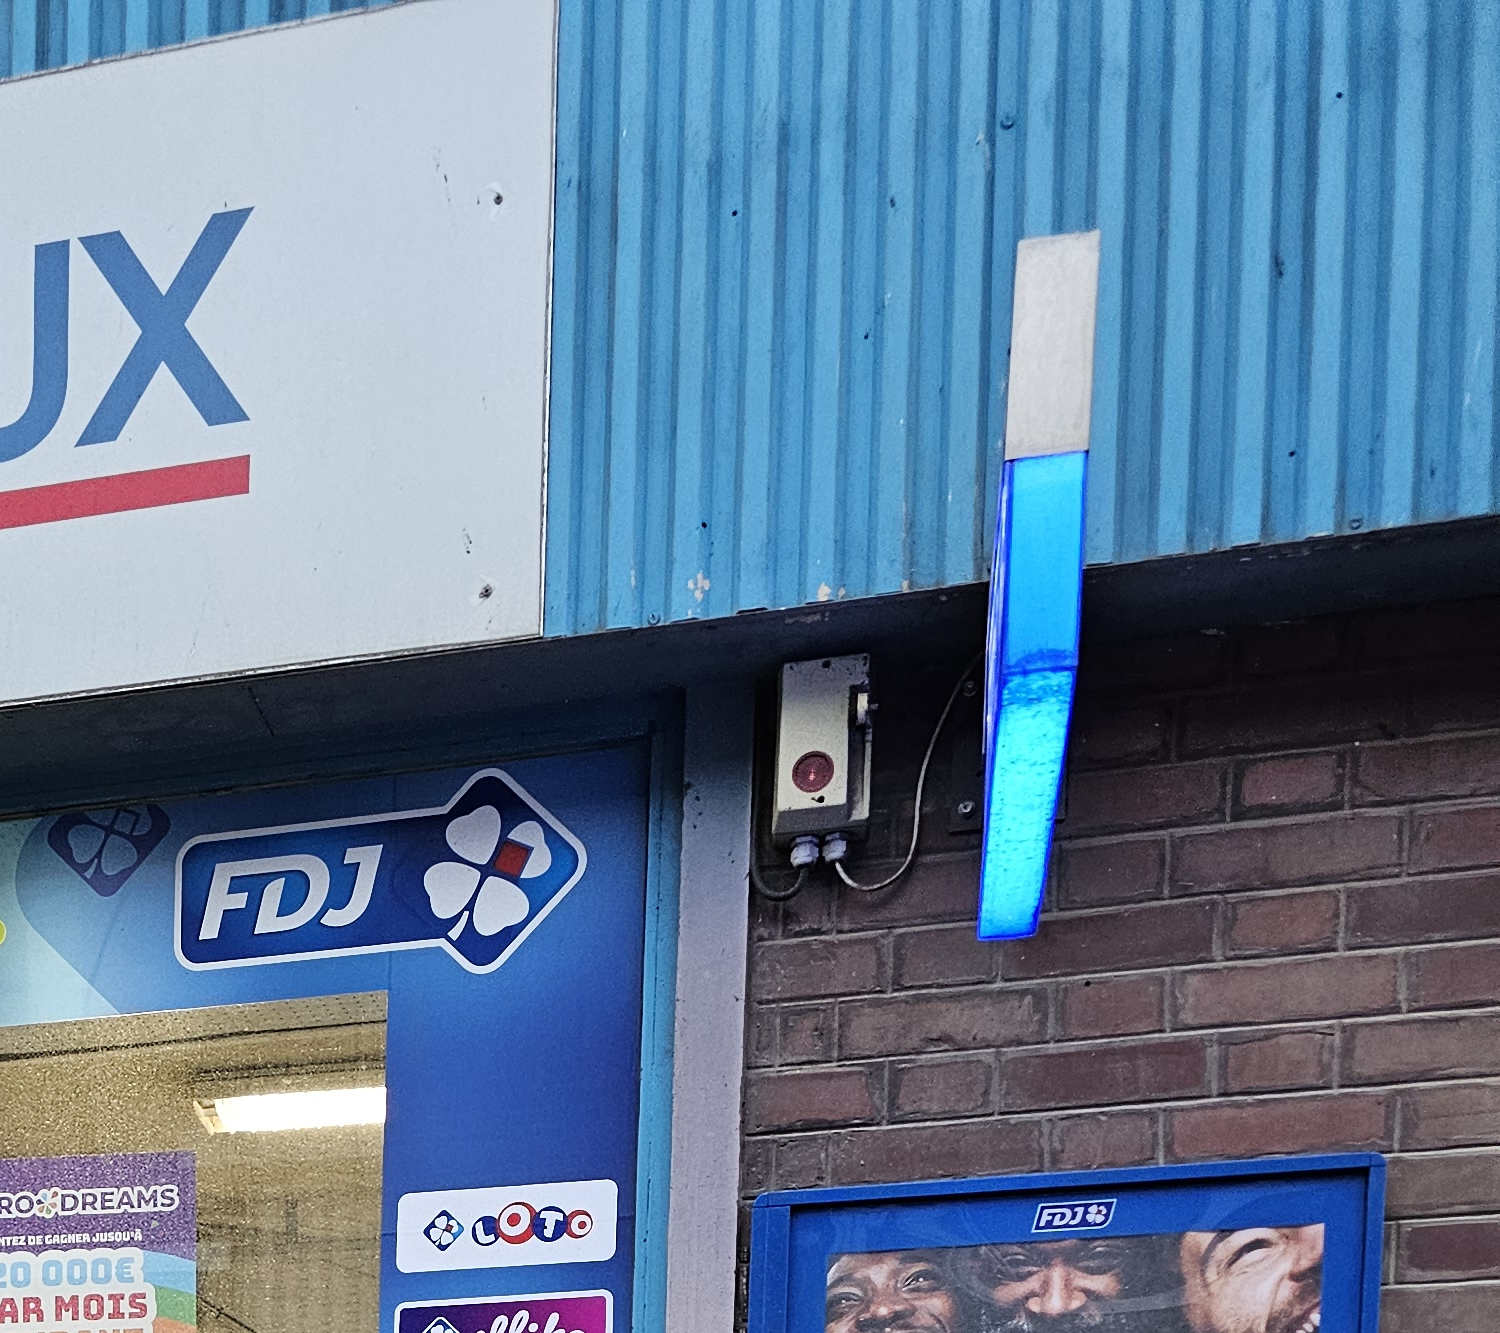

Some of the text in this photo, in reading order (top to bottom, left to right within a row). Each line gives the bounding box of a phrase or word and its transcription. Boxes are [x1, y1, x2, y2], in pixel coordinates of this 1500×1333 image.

[199, 845, 383, 940] FDJ
[61, 1188, 176, 1212] DREAMS
[472, 1202, 592, 1246] LOTO
[1039, 1207, 1084, 1226] FDJ
[28, 1236, 43, 1245] DE
[45, 1233, 90, 1244] GAGNER
[92, 1229, 142, 1242] JUSQU'À
[42, 1257, 135, 1286] 000€
[54, 1293, 148, 1321] MOIS
